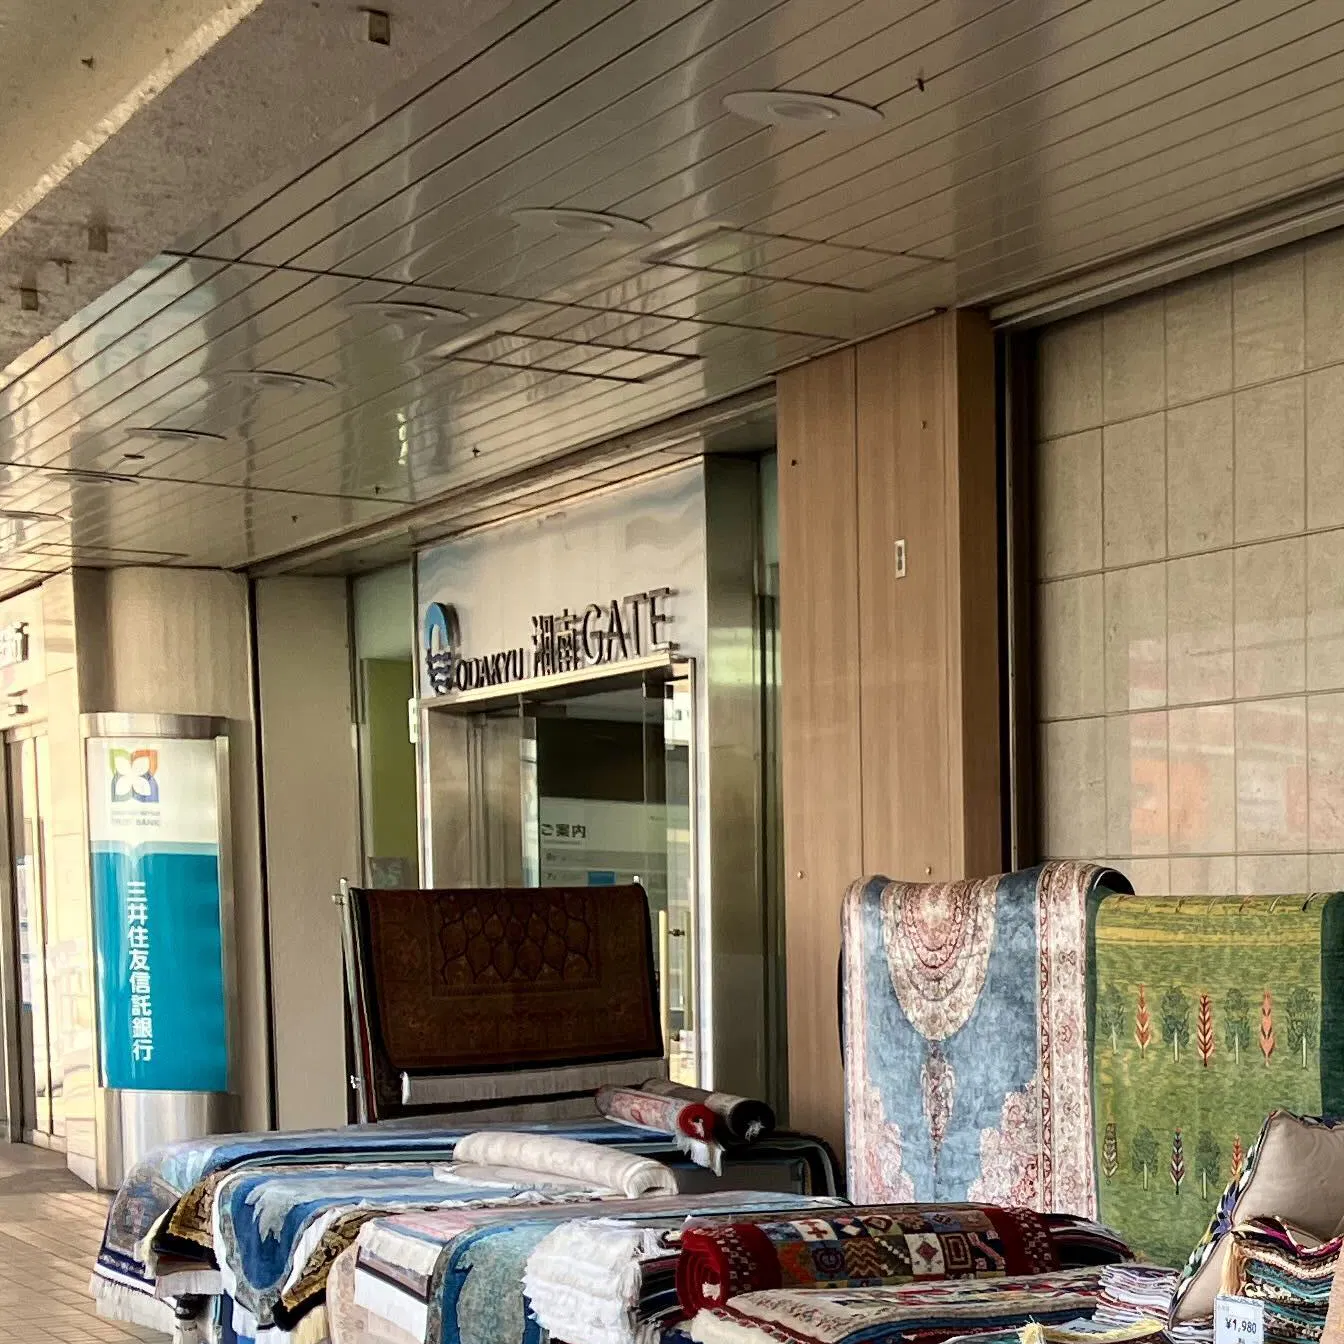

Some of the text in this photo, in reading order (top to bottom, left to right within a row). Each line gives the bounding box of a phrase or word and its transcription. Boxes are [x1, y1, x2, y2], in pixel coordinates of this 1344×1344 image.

[455, 647, 525, 692] ODAKYU
[540, 822, 587, 839] ご案内
[126, 880, 154, 1062] 三井住友信託銀行
[1224, 1317, 1258, 1335] ¥1,980
